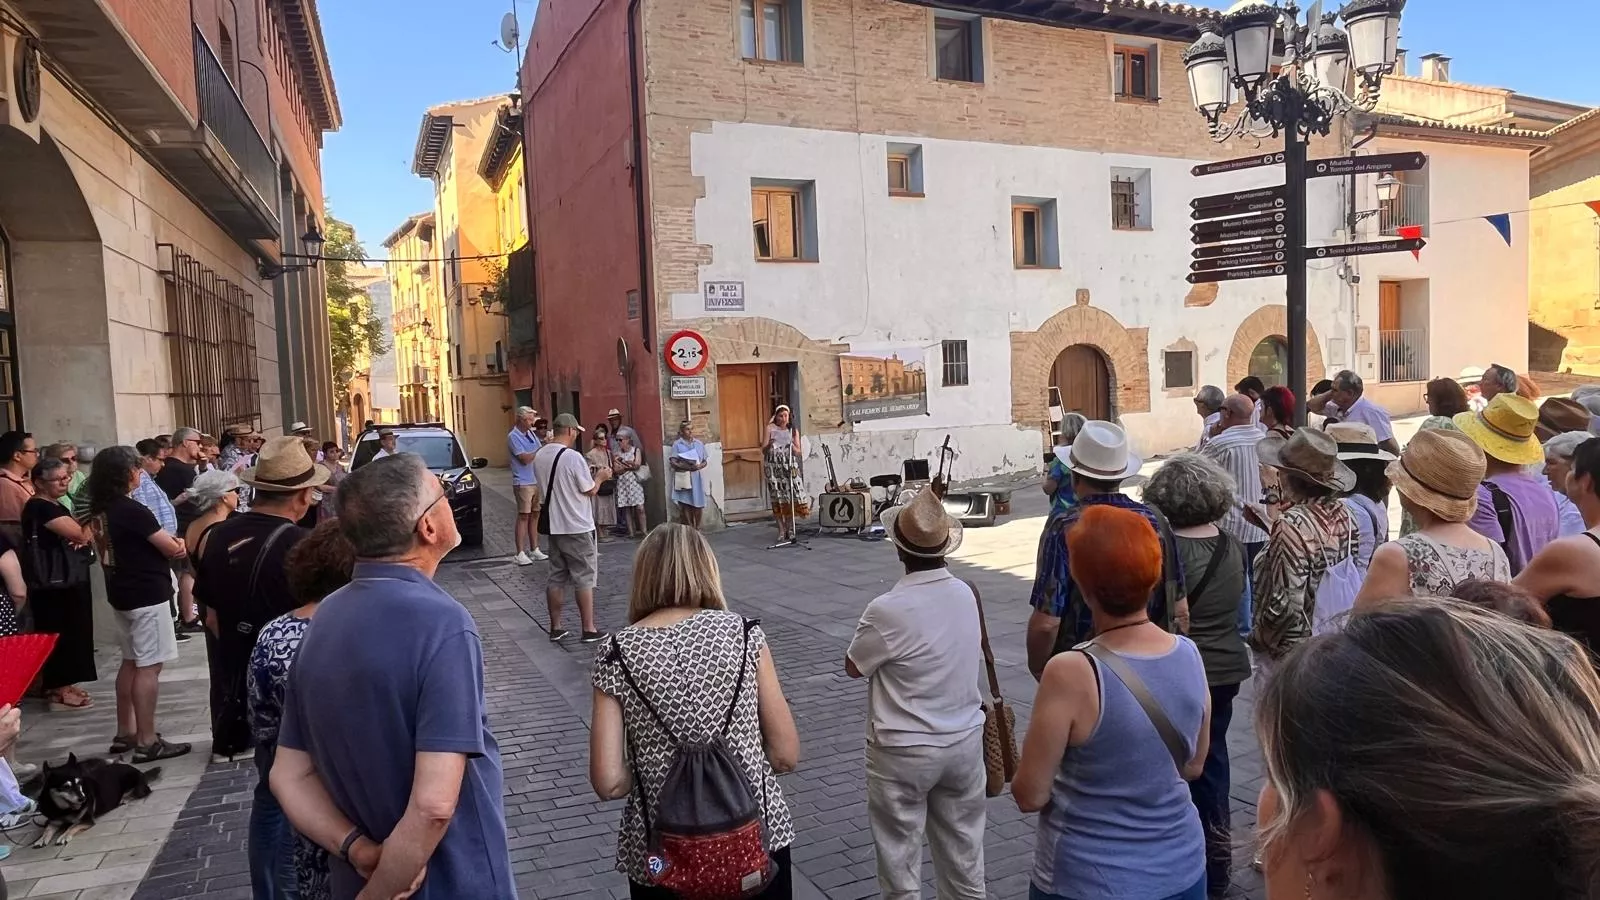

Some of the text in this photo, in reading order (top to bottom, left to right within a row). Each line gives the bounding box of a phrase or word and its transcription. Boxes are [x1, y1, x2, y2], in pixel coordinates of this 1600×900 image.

[1366, 163, 1392, 171] Amparo
[1233, 190, 1273, 201] Ayuntamiento
[1248, 201, 1273, 210] Catedral
[1251, 242, 1274, 250] Turismo
[1329, 247, 1345, 255] Torre
[1357, 244, 1381, 252] Palacio
[1382, 242, 1398, 250] Real
[1216, 258, 1239, 266] Parking
[1239, 254, 1273, 263] Universidad
[1227, 270, 1250, 278] Parking
[752, 345, 760, 358] 4
[881, 405, 888, 413] EL
